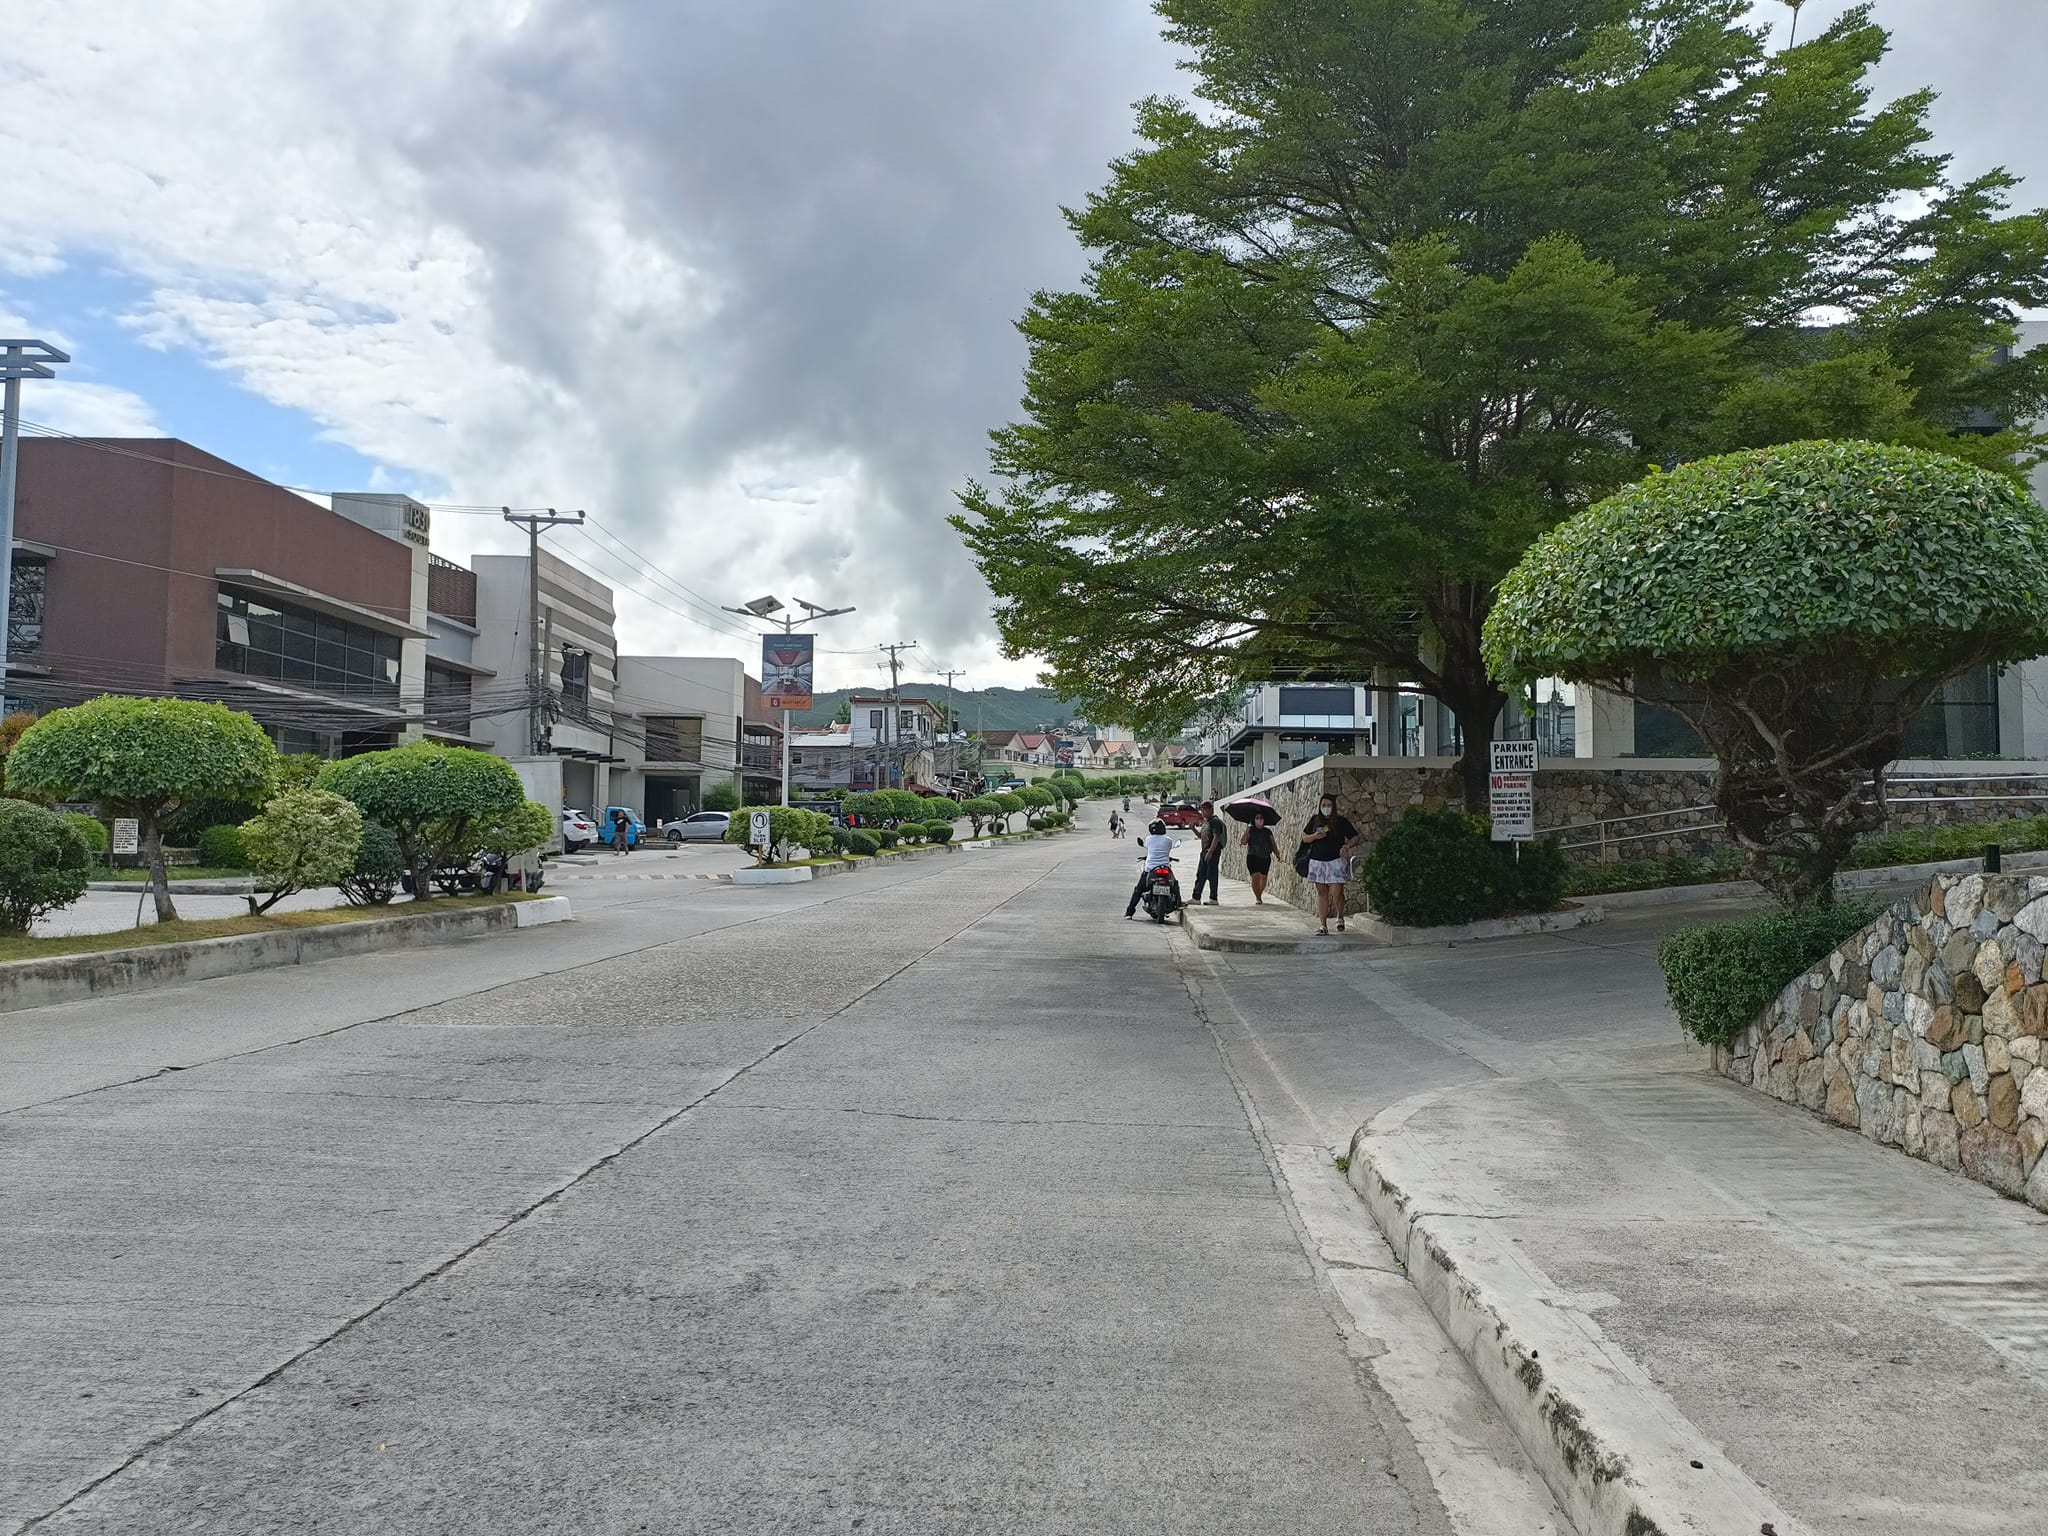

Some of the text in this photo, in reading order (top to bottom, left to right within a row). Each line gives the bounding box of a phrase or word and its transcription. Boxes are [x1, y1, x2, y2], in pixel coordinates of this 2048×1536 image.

[1494, 743, 1534, 753] PARKING
[1495, 754, 1534, 770] ENTRANCE
[1491, 775, 1503, 789] NO
